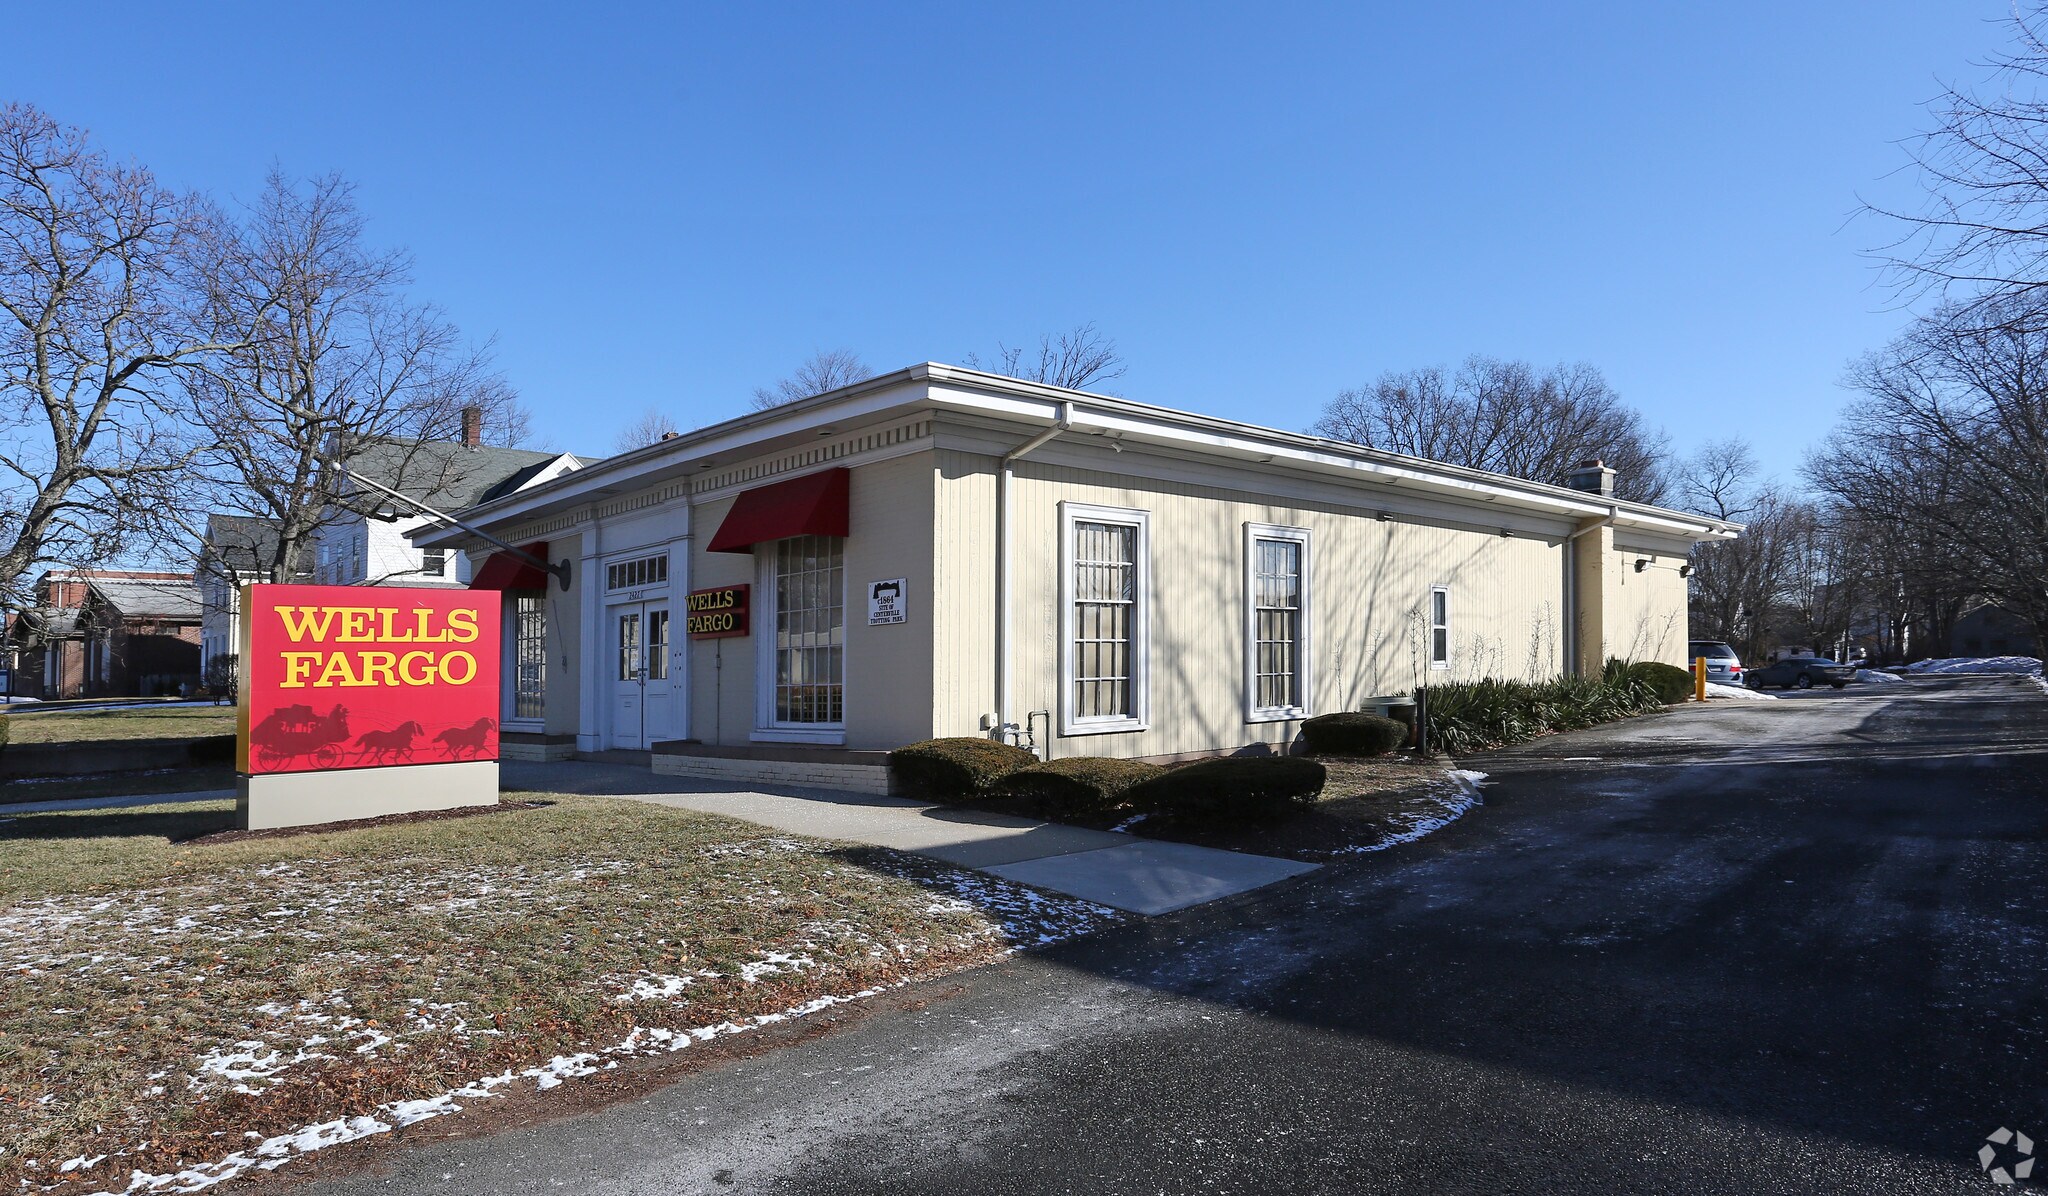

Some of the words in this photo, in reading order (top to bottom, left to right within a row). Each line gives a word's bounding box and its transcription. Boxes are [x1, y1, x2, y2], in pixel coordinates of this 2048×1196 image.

[685, 590, 734, 612] WELLS
[274, 605, 479, 643] WELLS
[687, 612, 733, 634] FARGO
[279, 650, 478, 688] FARGO
